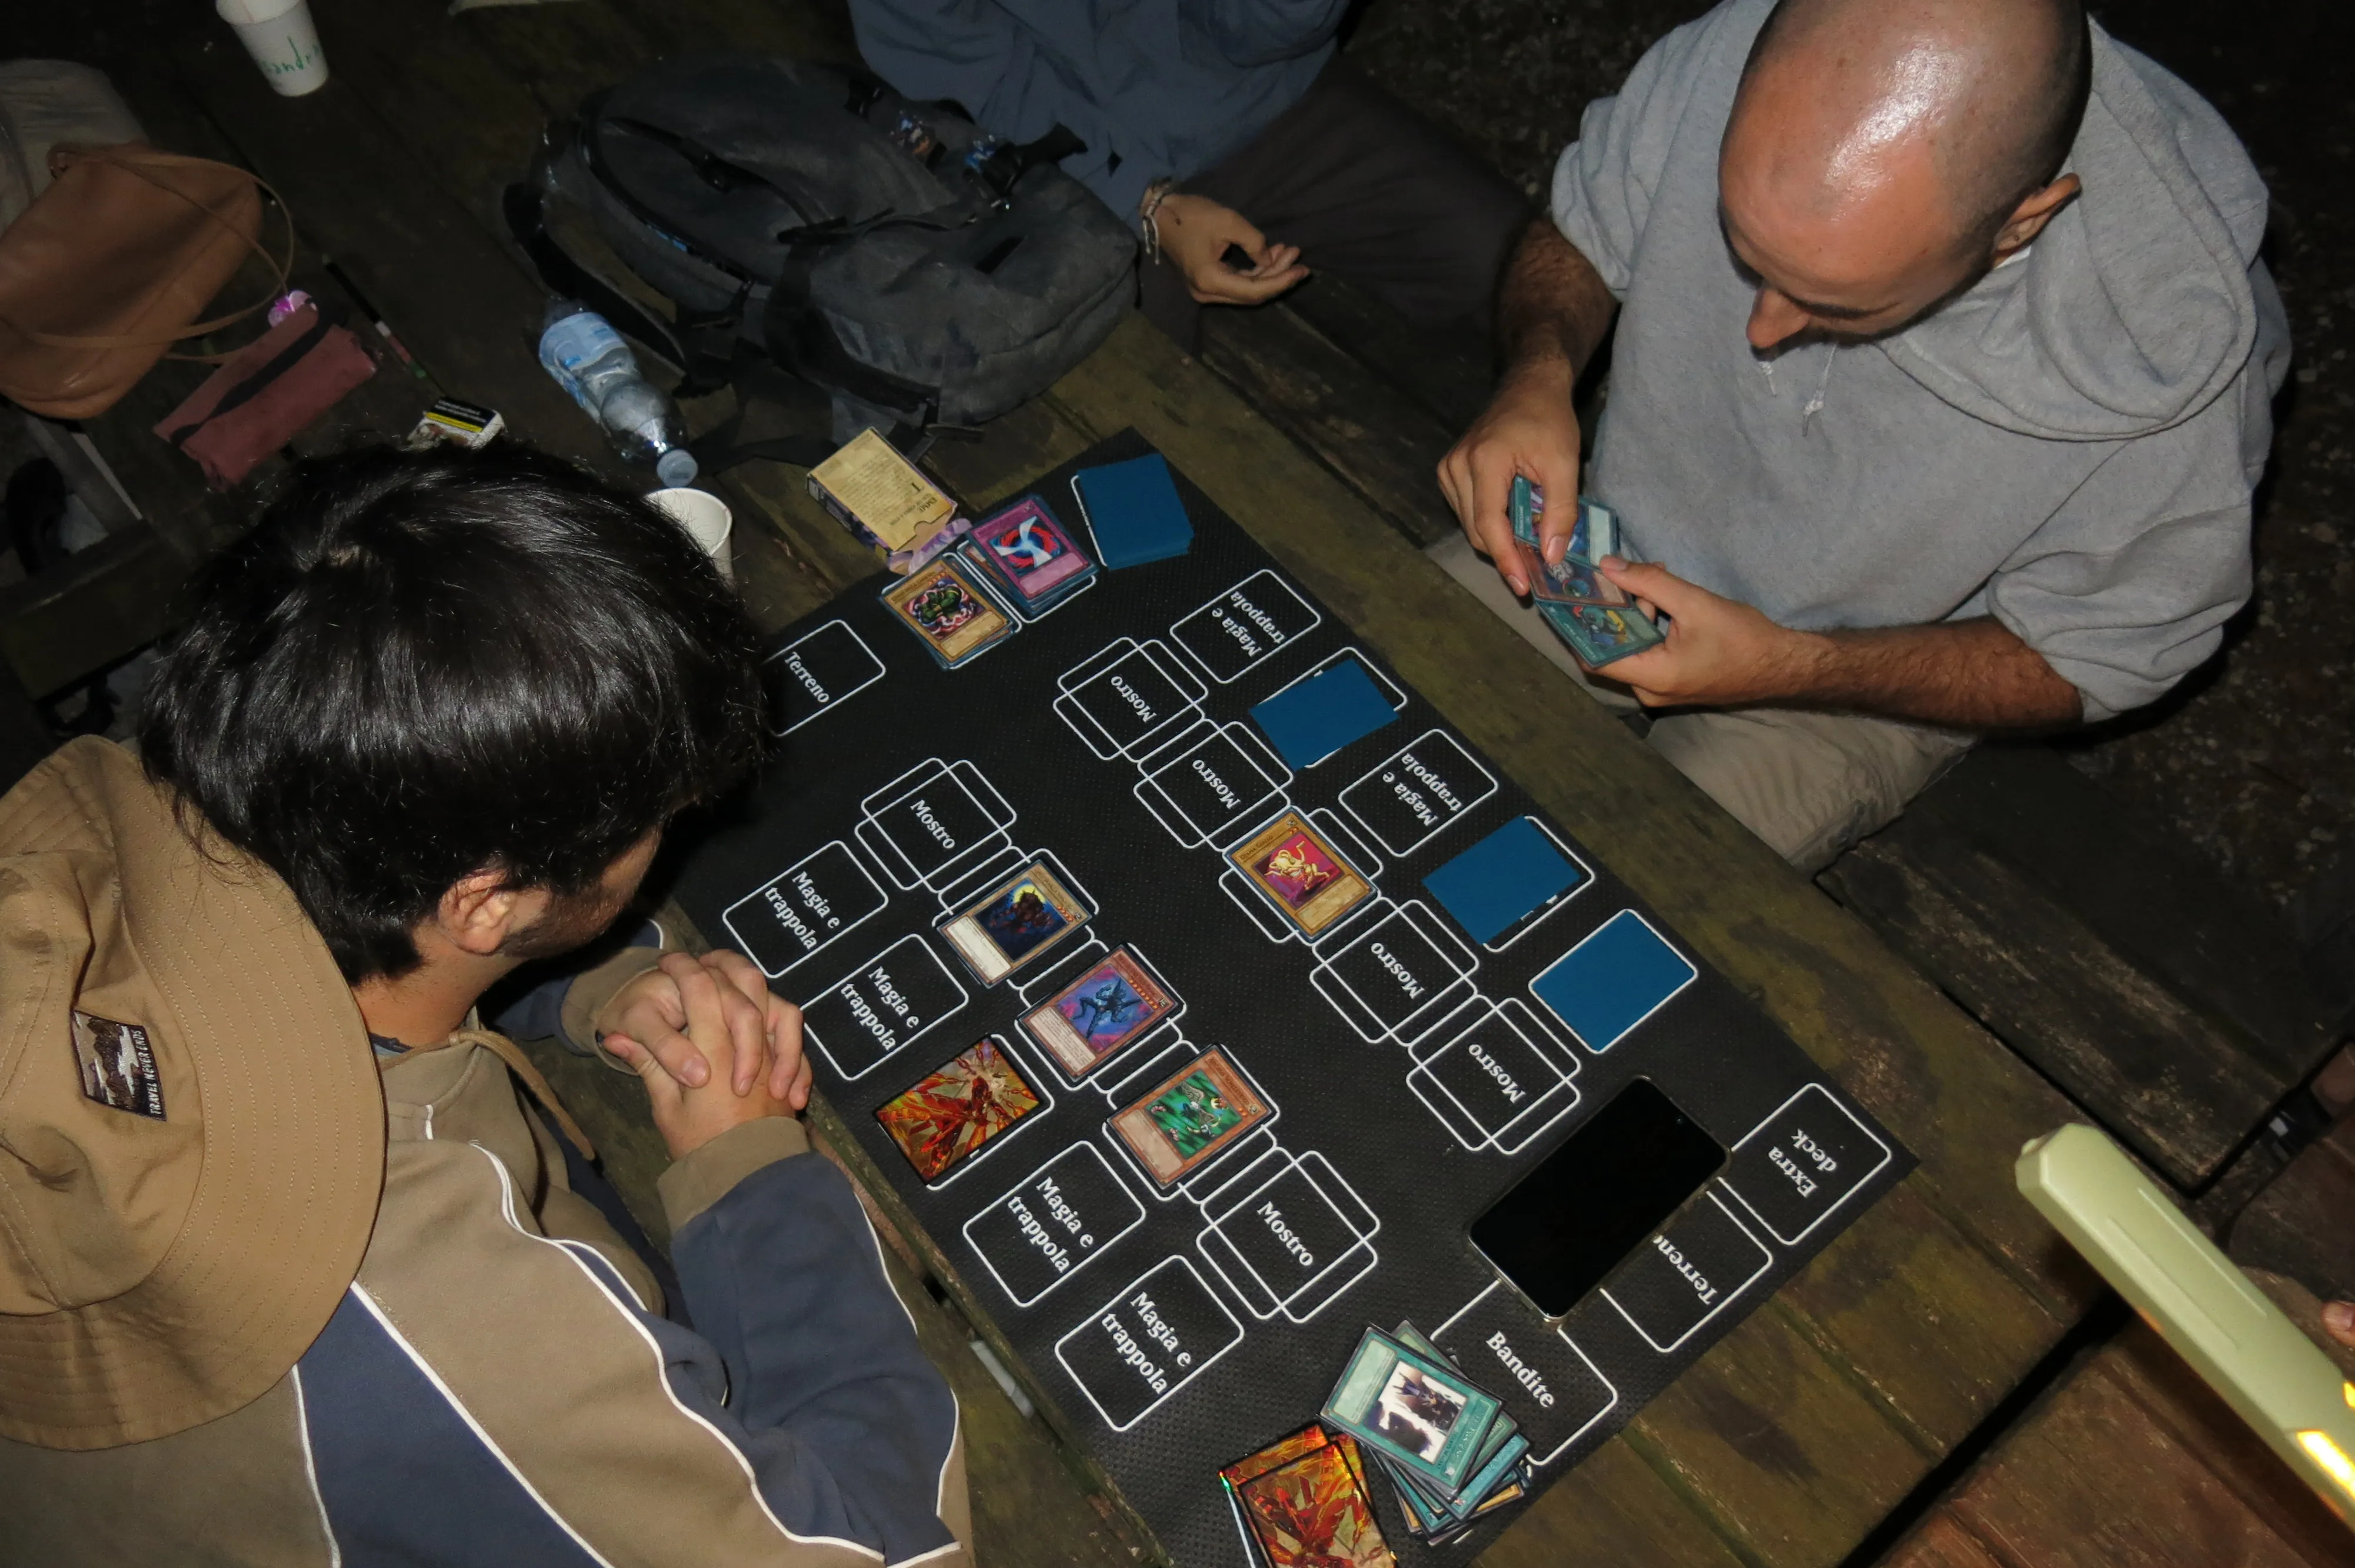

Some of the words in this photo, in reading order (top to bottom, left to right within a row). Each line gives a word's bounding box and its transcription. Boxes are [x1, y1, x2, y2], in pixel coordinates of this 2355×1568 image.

[1212, 608, 1223, 617] e
[1222, 617, 1262, 656] Magia
[1231, 592, 1285, 643] trappola
[784, 651, 830, 703] Terreno
[1111, 676, 1156, 722] Mostro
[1192, 760, 1240, 809] Mostro
[1383, 772, 1395, 782] e
[1402, 753, 1462, 811] trappola
[910, 799, 955, 849] Mostro
[1394, 783, 1438, 826] Magia
[765, 888, 817, 949] trappola
[792, 871, 830, 918] Magia
[827, 918, 840, 928] e
[868, 966, 908, 1016] Magia
[907, 1016, 918, 1028] e
[1371, 943, 1425, 999] Mostro
[132, 1029, 148, 1051] ENDS
[841, 984, 895, 1051] trappola
[138, 1052, 156, 1081] NEVER
[1469, 1044, 1525, 1103] Mostro
[147, 1082, 162, 1115] TRAVEL
[1769, 1147, 1817, 1197] Extra
[1792, 1129, 1837, 1171] deck
[1008, 1197, 1070, 1273] trappola
[1036, 1177, 1082, 1234] Magia
[1080, 1234, 1093, 1248] e
[1257, 1201, 1314, 1267] Mostro
[1102, 1314, 1167, 1394] trappola
[1130, 1291, 1179, 1353] Magia
[1177, 1352, 1191, 1367] e
[1485, 1331, 1554, 1408] Bandite
